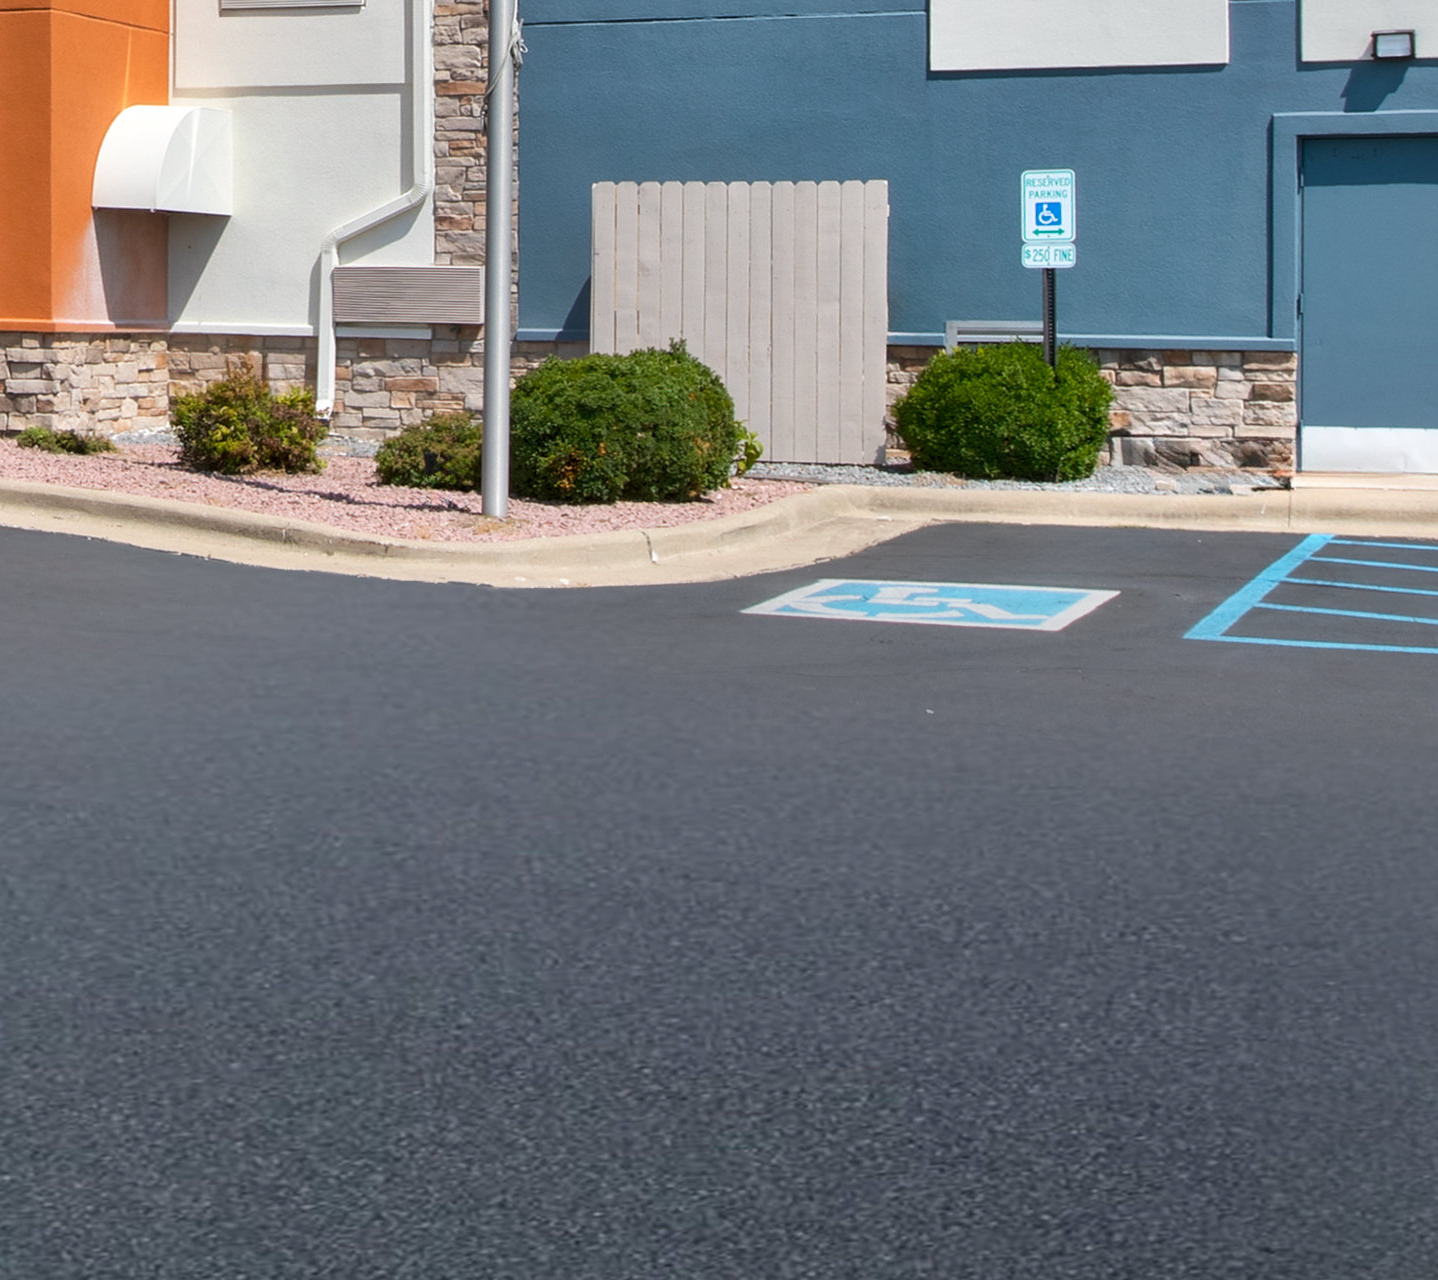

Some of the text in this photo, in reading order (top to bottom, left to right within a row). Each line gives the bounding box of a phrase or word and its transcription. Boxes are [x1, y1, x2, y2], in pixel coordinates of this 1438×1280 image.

[1025, 177, 1071, 187] RESERVED
[1028, 190, 1068, 199] PARKING
[1053, 249, 1074, 262] FINE
